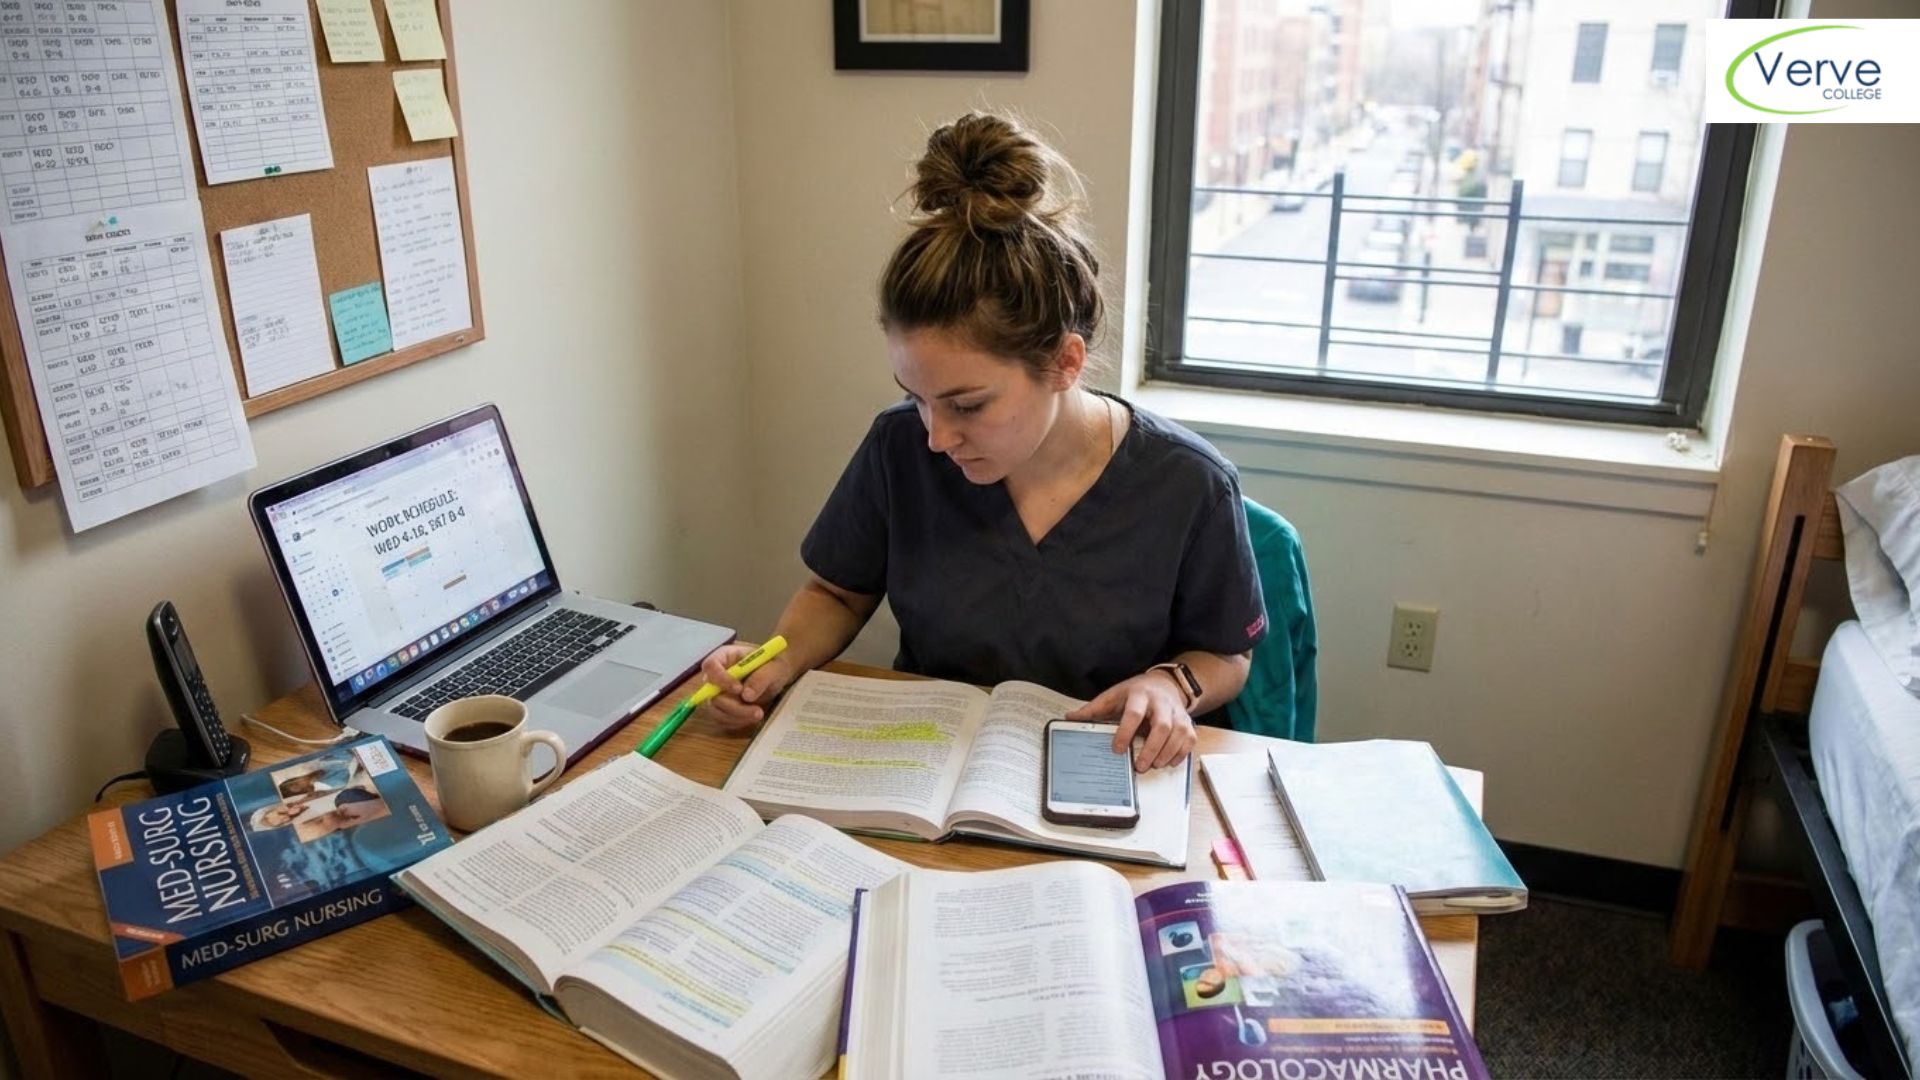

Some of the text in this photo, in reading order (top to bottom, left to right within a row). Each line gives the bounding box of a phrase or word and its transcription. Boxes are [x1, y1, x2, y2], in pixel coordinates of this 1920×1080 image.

[138, 806, 203, 924] MED-SURG
[176, 796, 247, 912] NURSING
[181, 888, 383, 970] MED-SURG NURSING
[1196, 1057, 1469, 1080] PHARMACOLOGY
